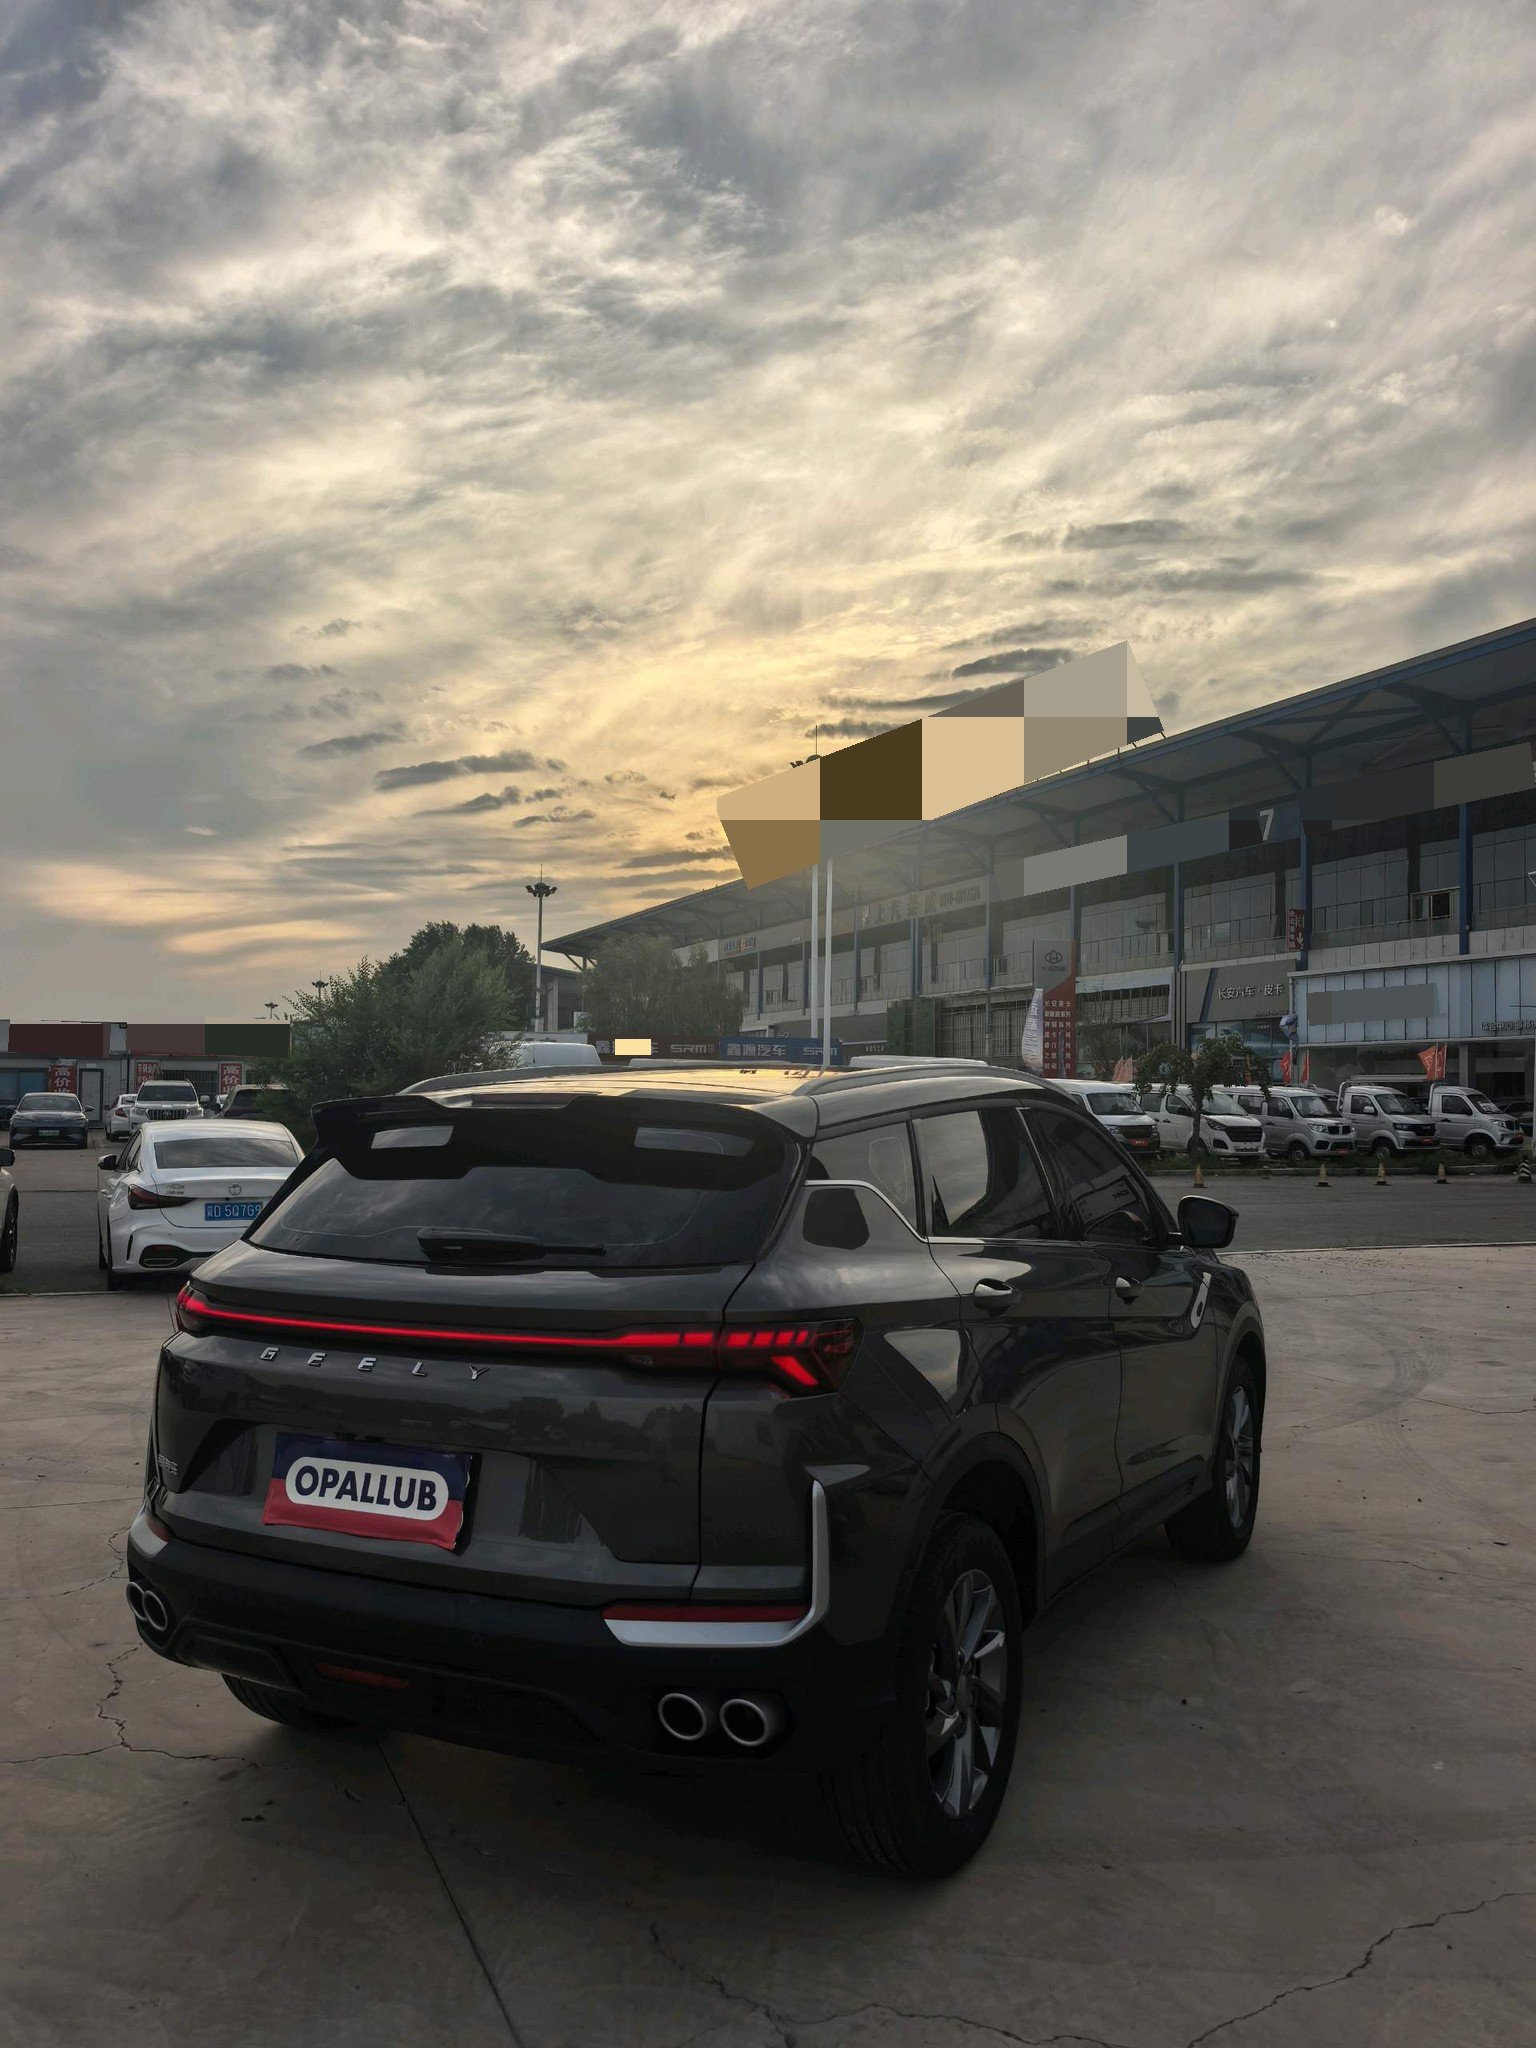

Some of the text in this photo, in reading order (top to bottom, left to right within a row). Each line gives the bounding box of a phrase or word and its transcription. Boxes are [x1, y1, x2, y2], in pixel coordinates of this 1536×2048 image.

[726, 1043, 787, 1057] 鑫源汽车
[260, 1346, 490, 1382] GEELY
[294, 1465, 438, 1512] OPALLUB
